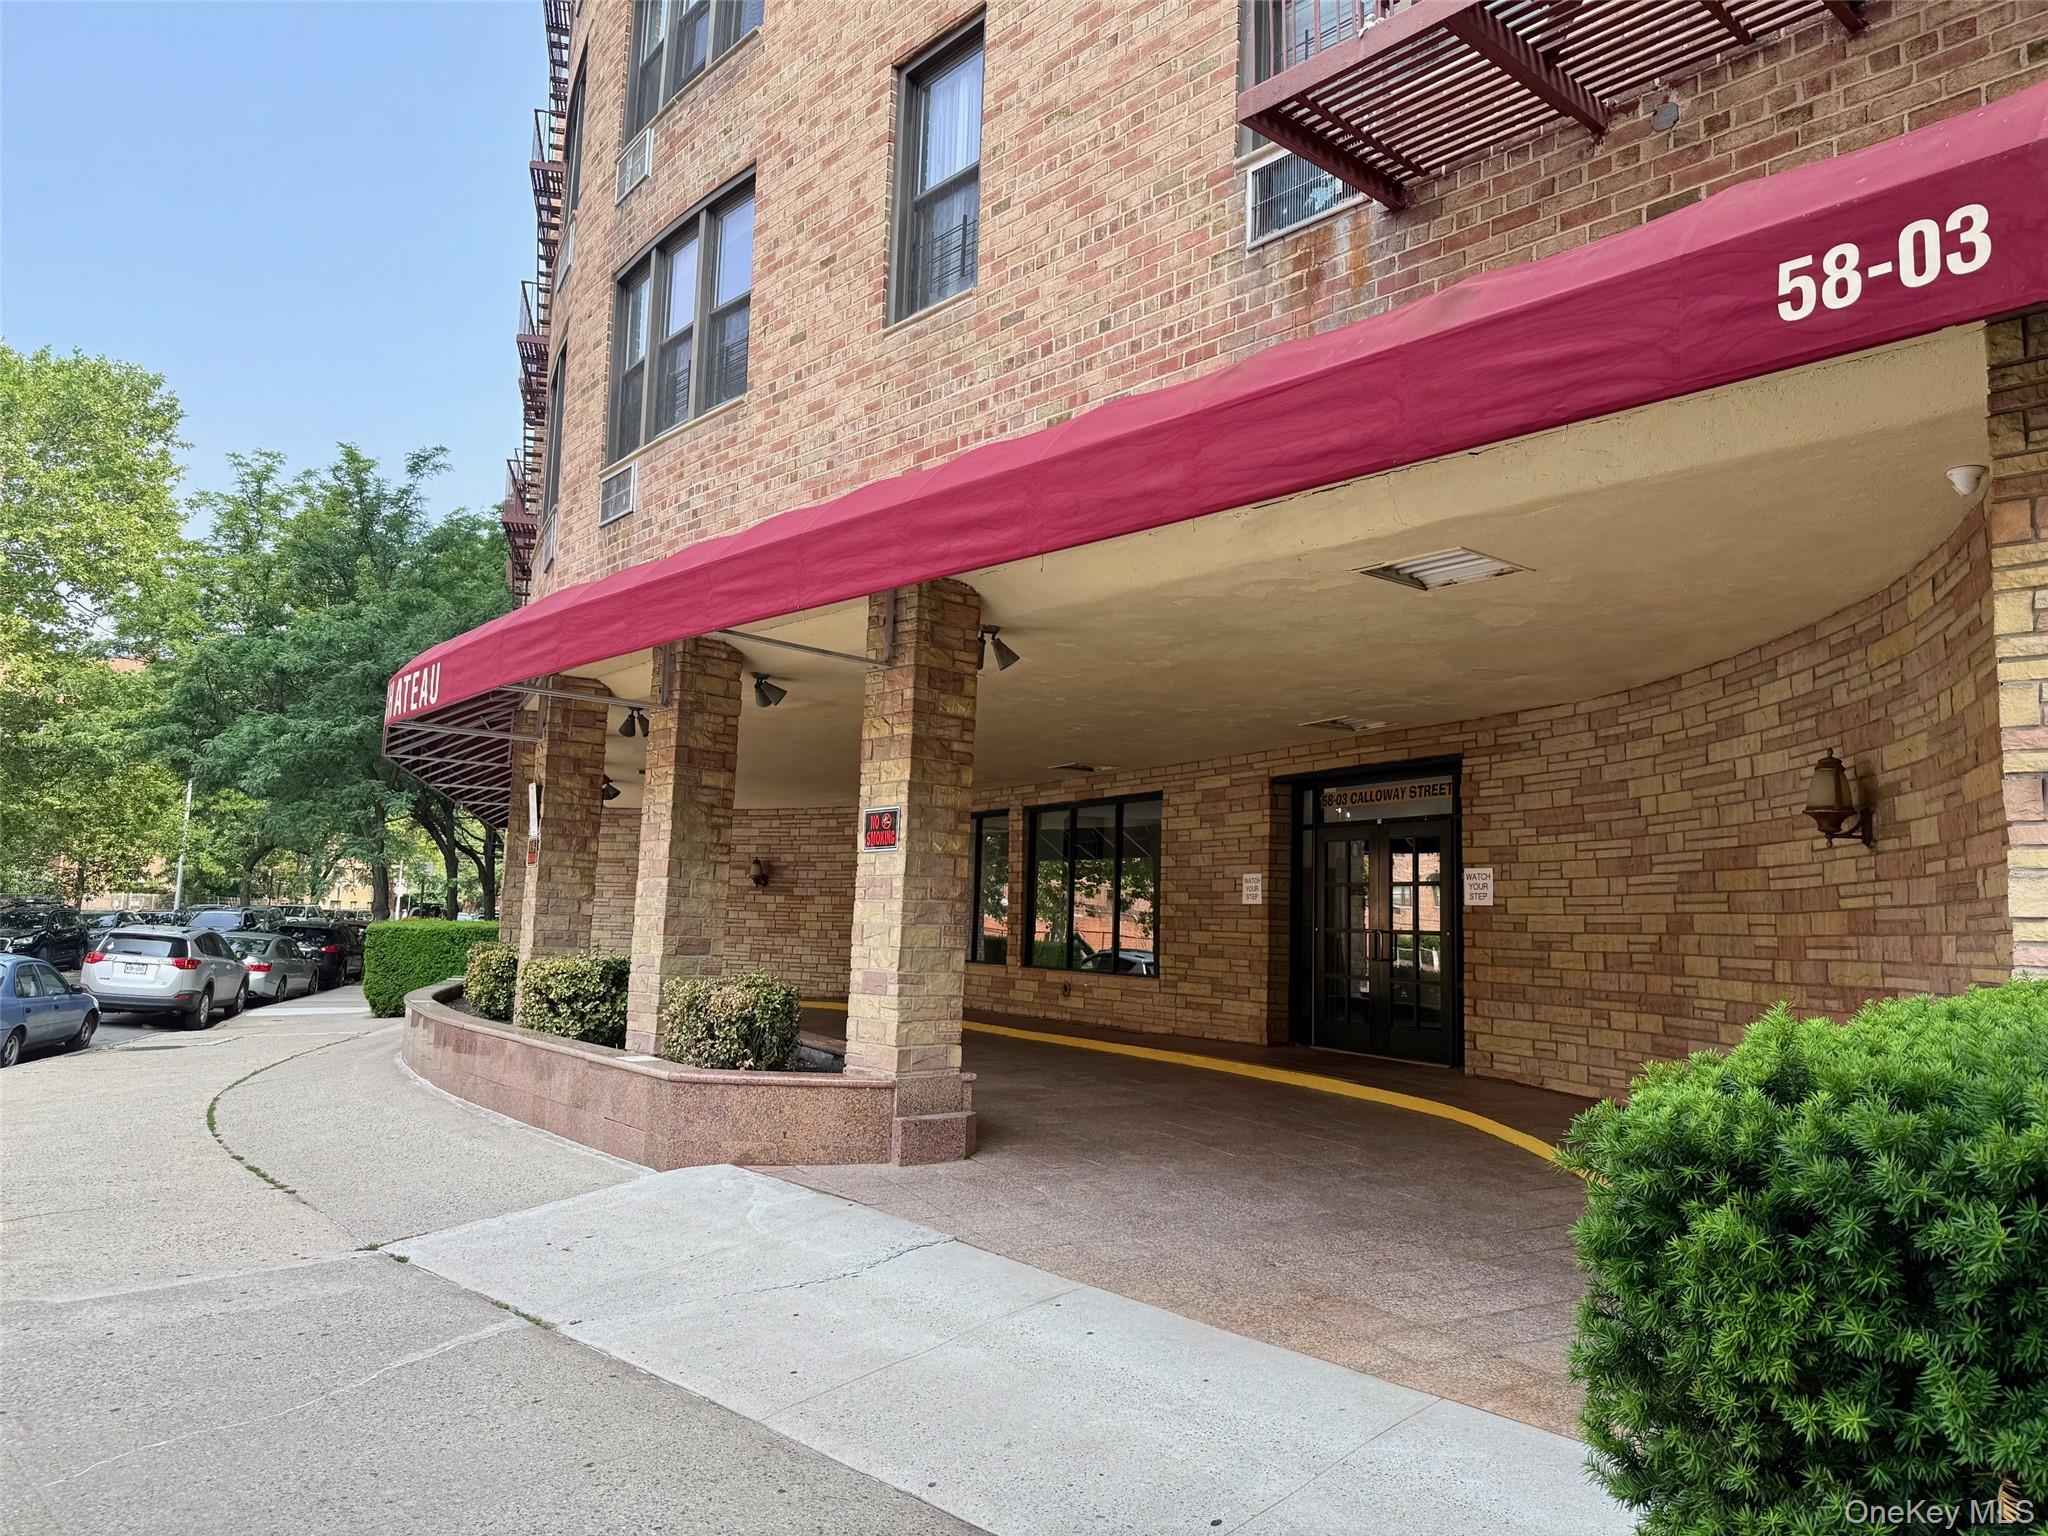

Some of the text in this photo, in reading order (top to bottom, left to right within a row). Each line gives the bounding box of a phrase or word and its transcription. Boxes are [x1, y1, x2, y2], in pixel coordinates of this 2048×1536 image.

[1777, 203, 1992, 321] 58-03
[1322, 782, 1453, 807] 58-03 CALLOWAY STREET
[870, 815, 880, 830] NO
[866, 831, 895, 846] SMOKING
[1465, 872, 1491, 881] WATCH
[1469, 882, 1488, 891] YOUR
[1469, 892, 1488, 900] STEP
